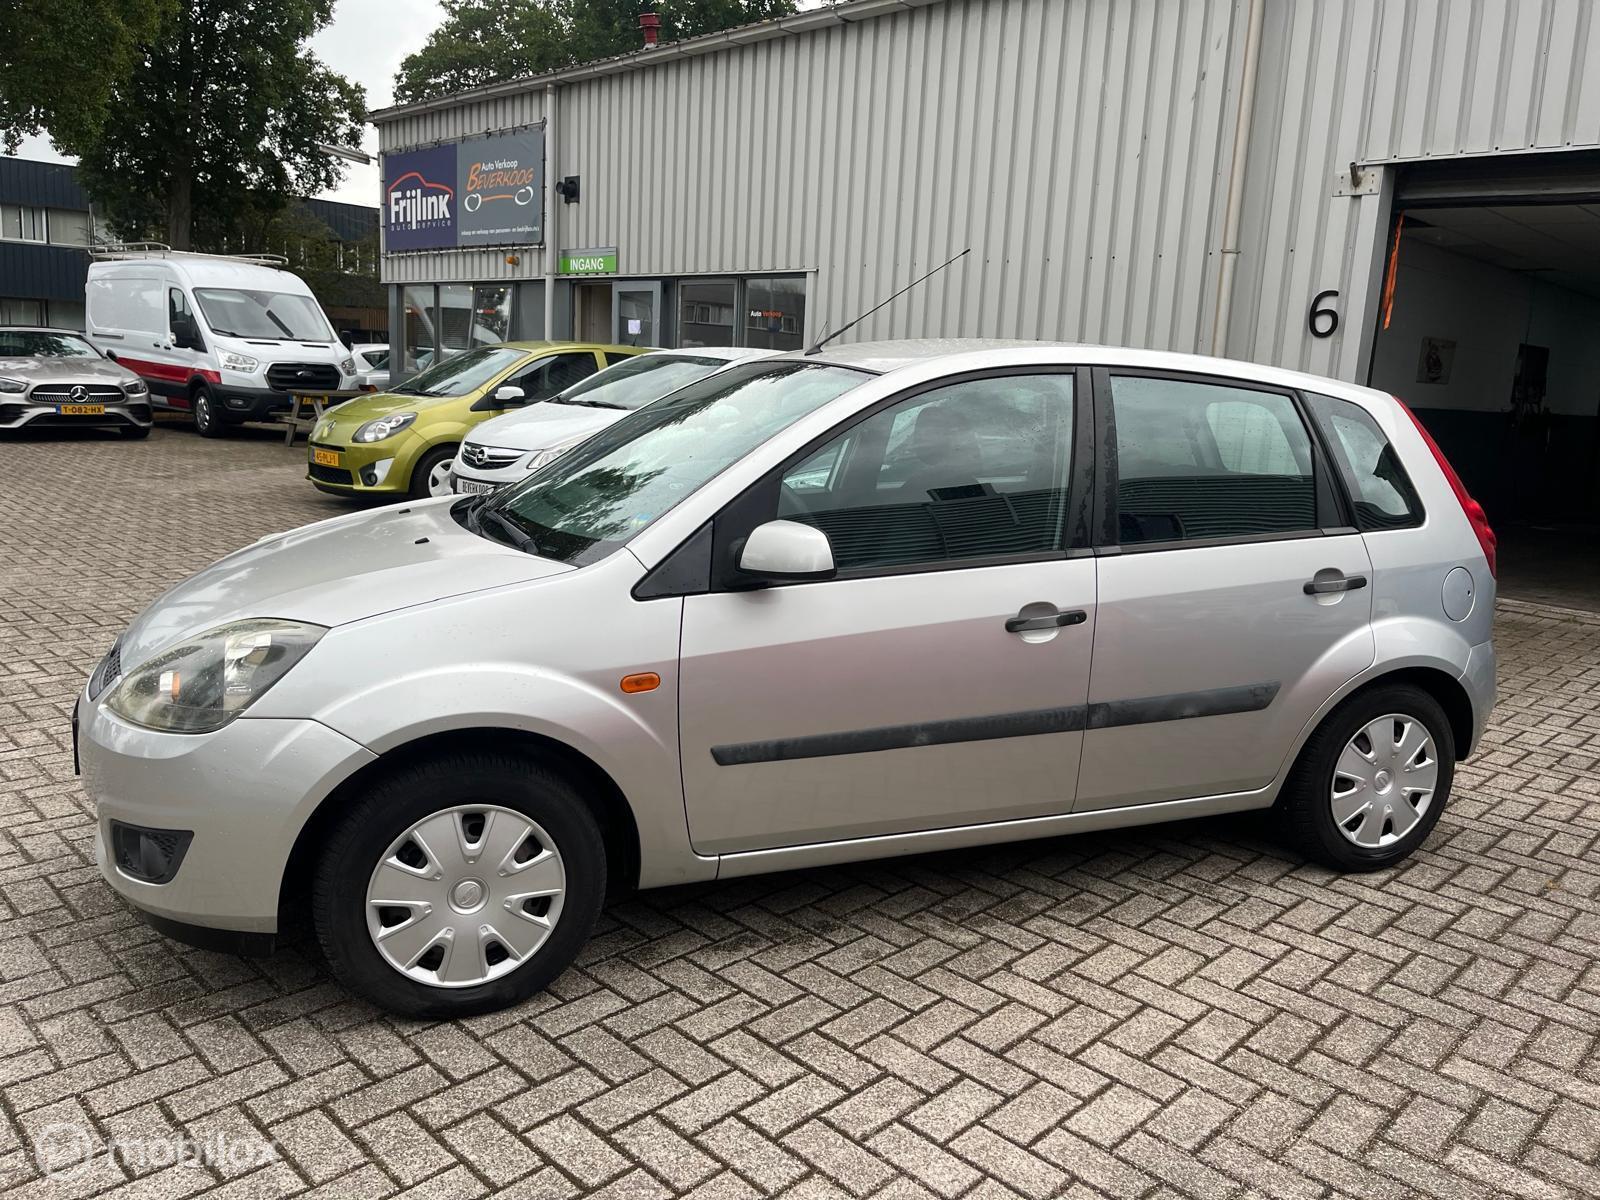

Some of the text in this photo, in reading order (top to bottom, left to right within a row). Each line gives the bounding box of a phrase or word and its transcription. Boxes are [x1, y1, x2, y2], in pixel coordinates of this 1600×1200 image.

[481, 158, 518, 171] Auto Verkoop
[466, 162, 534, 192] BEVERKOOG
[570, 257, 604, 271] INGANG
[1309, 290, 1339, 339] 6
[62, 406, 103, 414] T-082-HX
